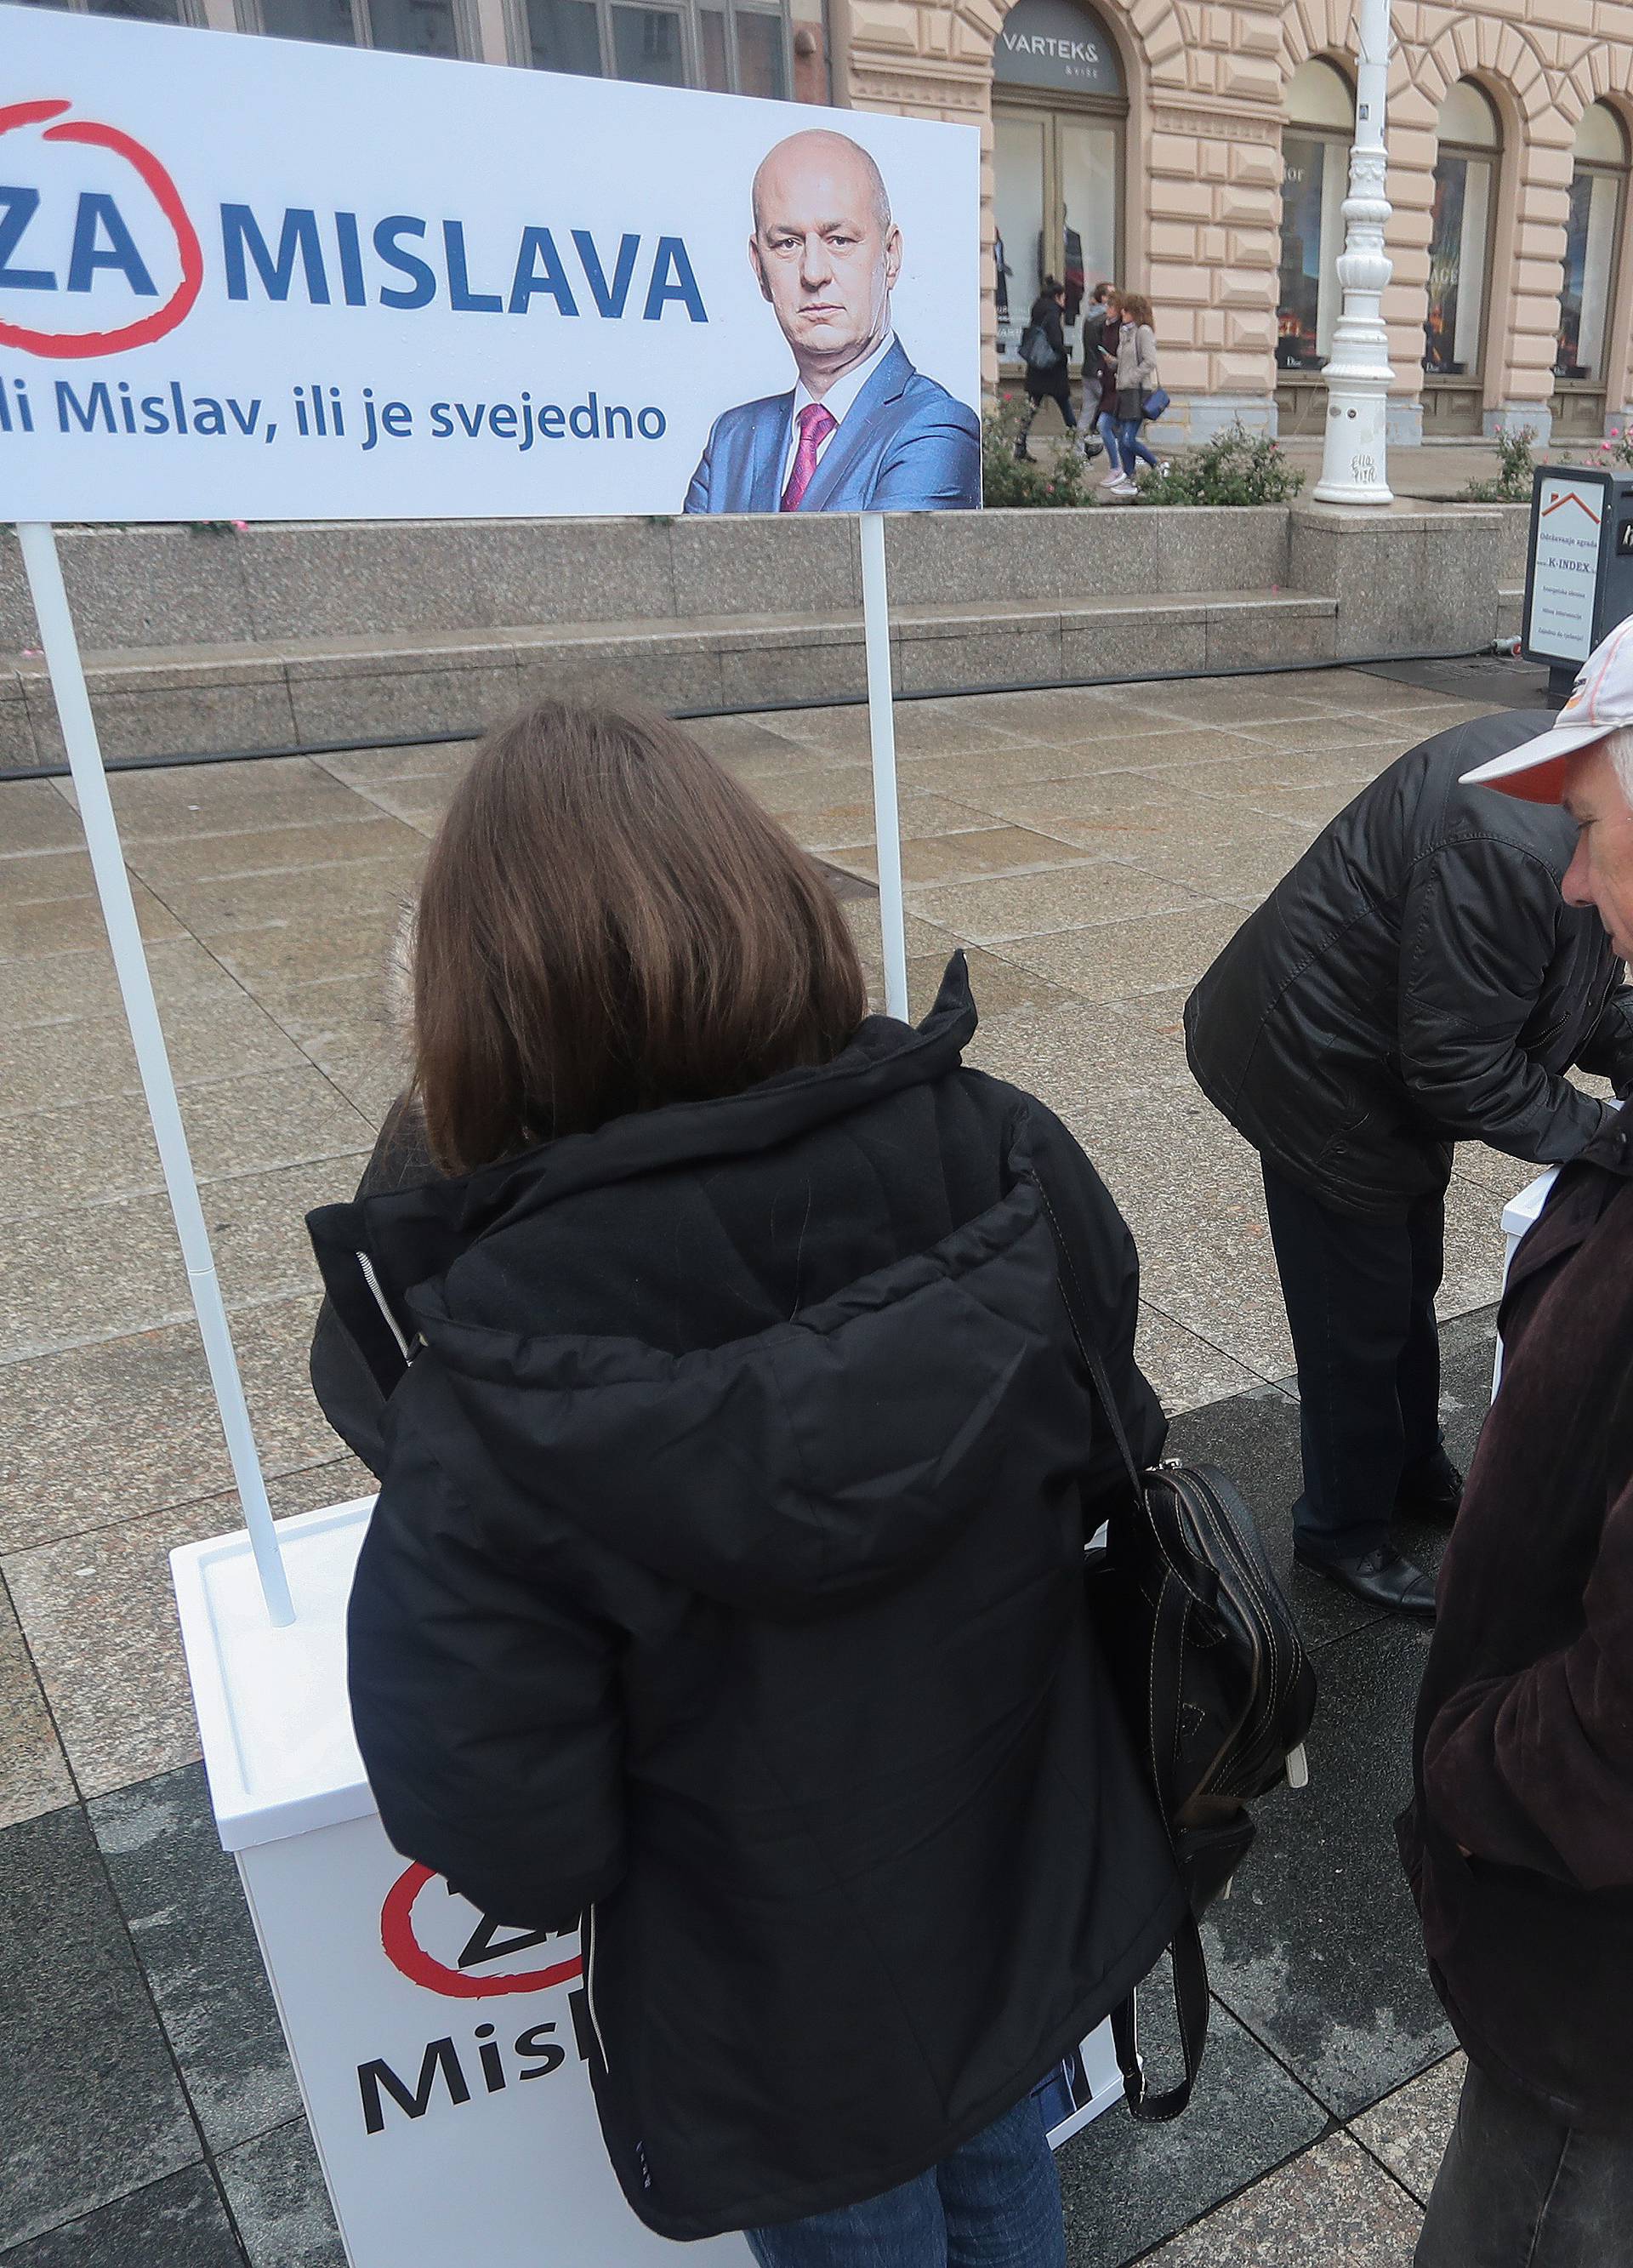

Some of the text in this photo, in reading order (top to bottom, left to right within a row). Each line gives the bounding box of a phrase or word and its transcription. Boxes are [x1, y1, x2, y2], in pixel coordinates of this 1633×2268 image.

[1003, 31, 1099, 63] VARTEKS
[0, 185, 708, 322] ZA MISLAVA
[54, 379, 276, 443] Mislav,
[293, 385, 344, 436] ili
[362, 388, 413, 450] je
[430, 391, 666, 451] svejedno
